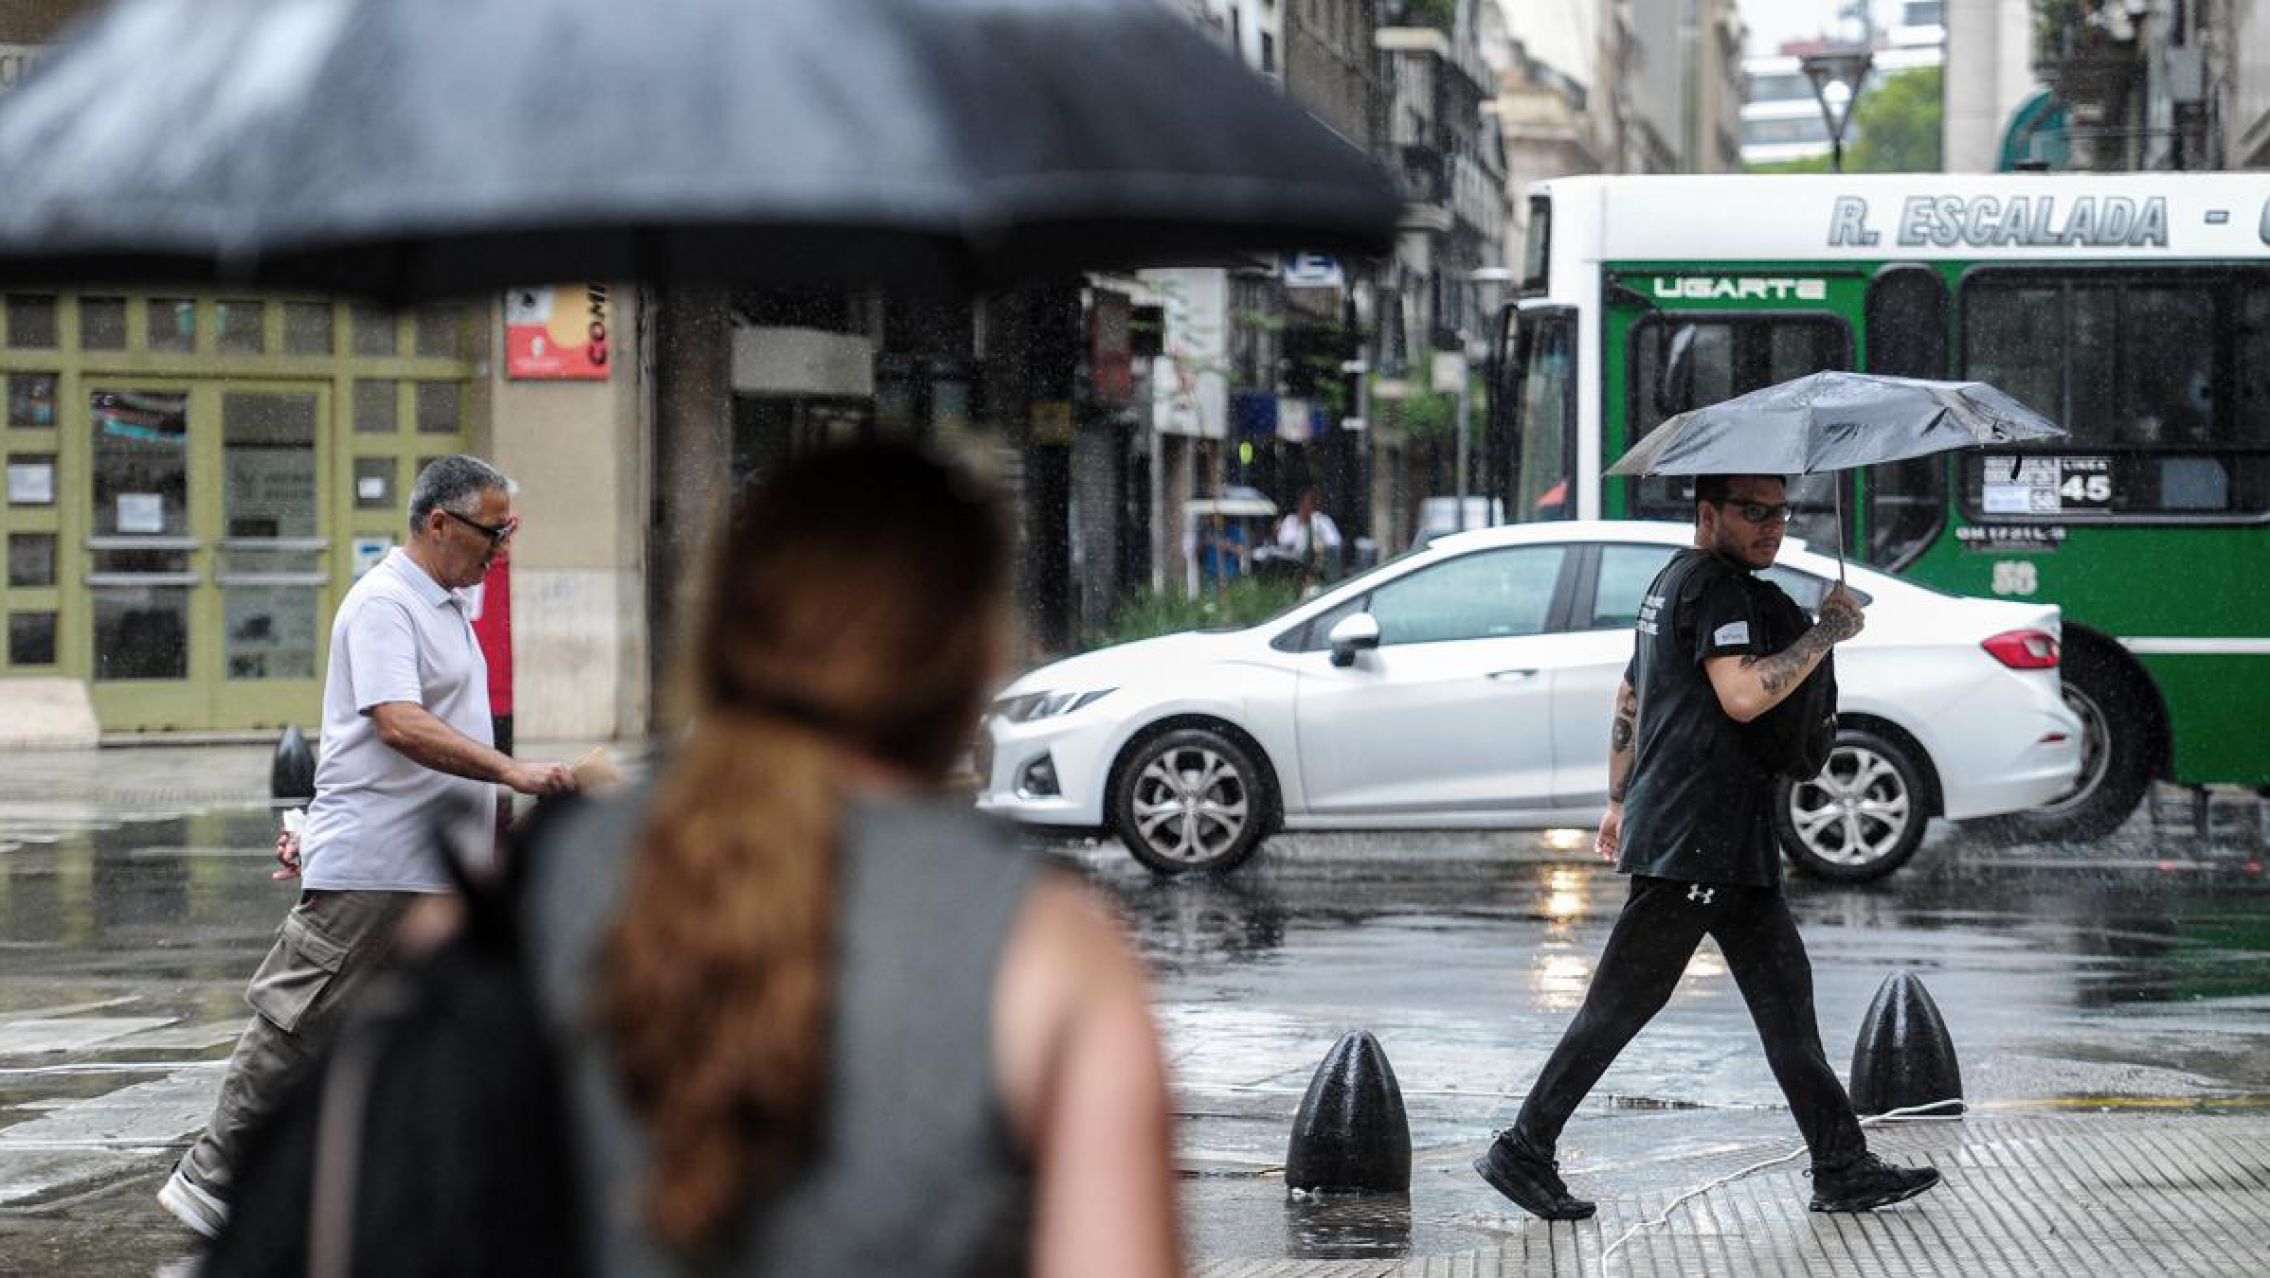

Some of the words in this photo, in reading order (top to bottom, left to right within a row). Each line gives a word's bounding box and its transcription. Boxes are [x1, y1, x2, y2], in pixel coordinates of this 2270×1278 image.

[1828, 196, 1880, 247] R.
[1896, 195, 2169, 248] ESCALADA
[1654, 277, 1826, 299] UGARTE
[2061, 474, 2112, 501] 45
